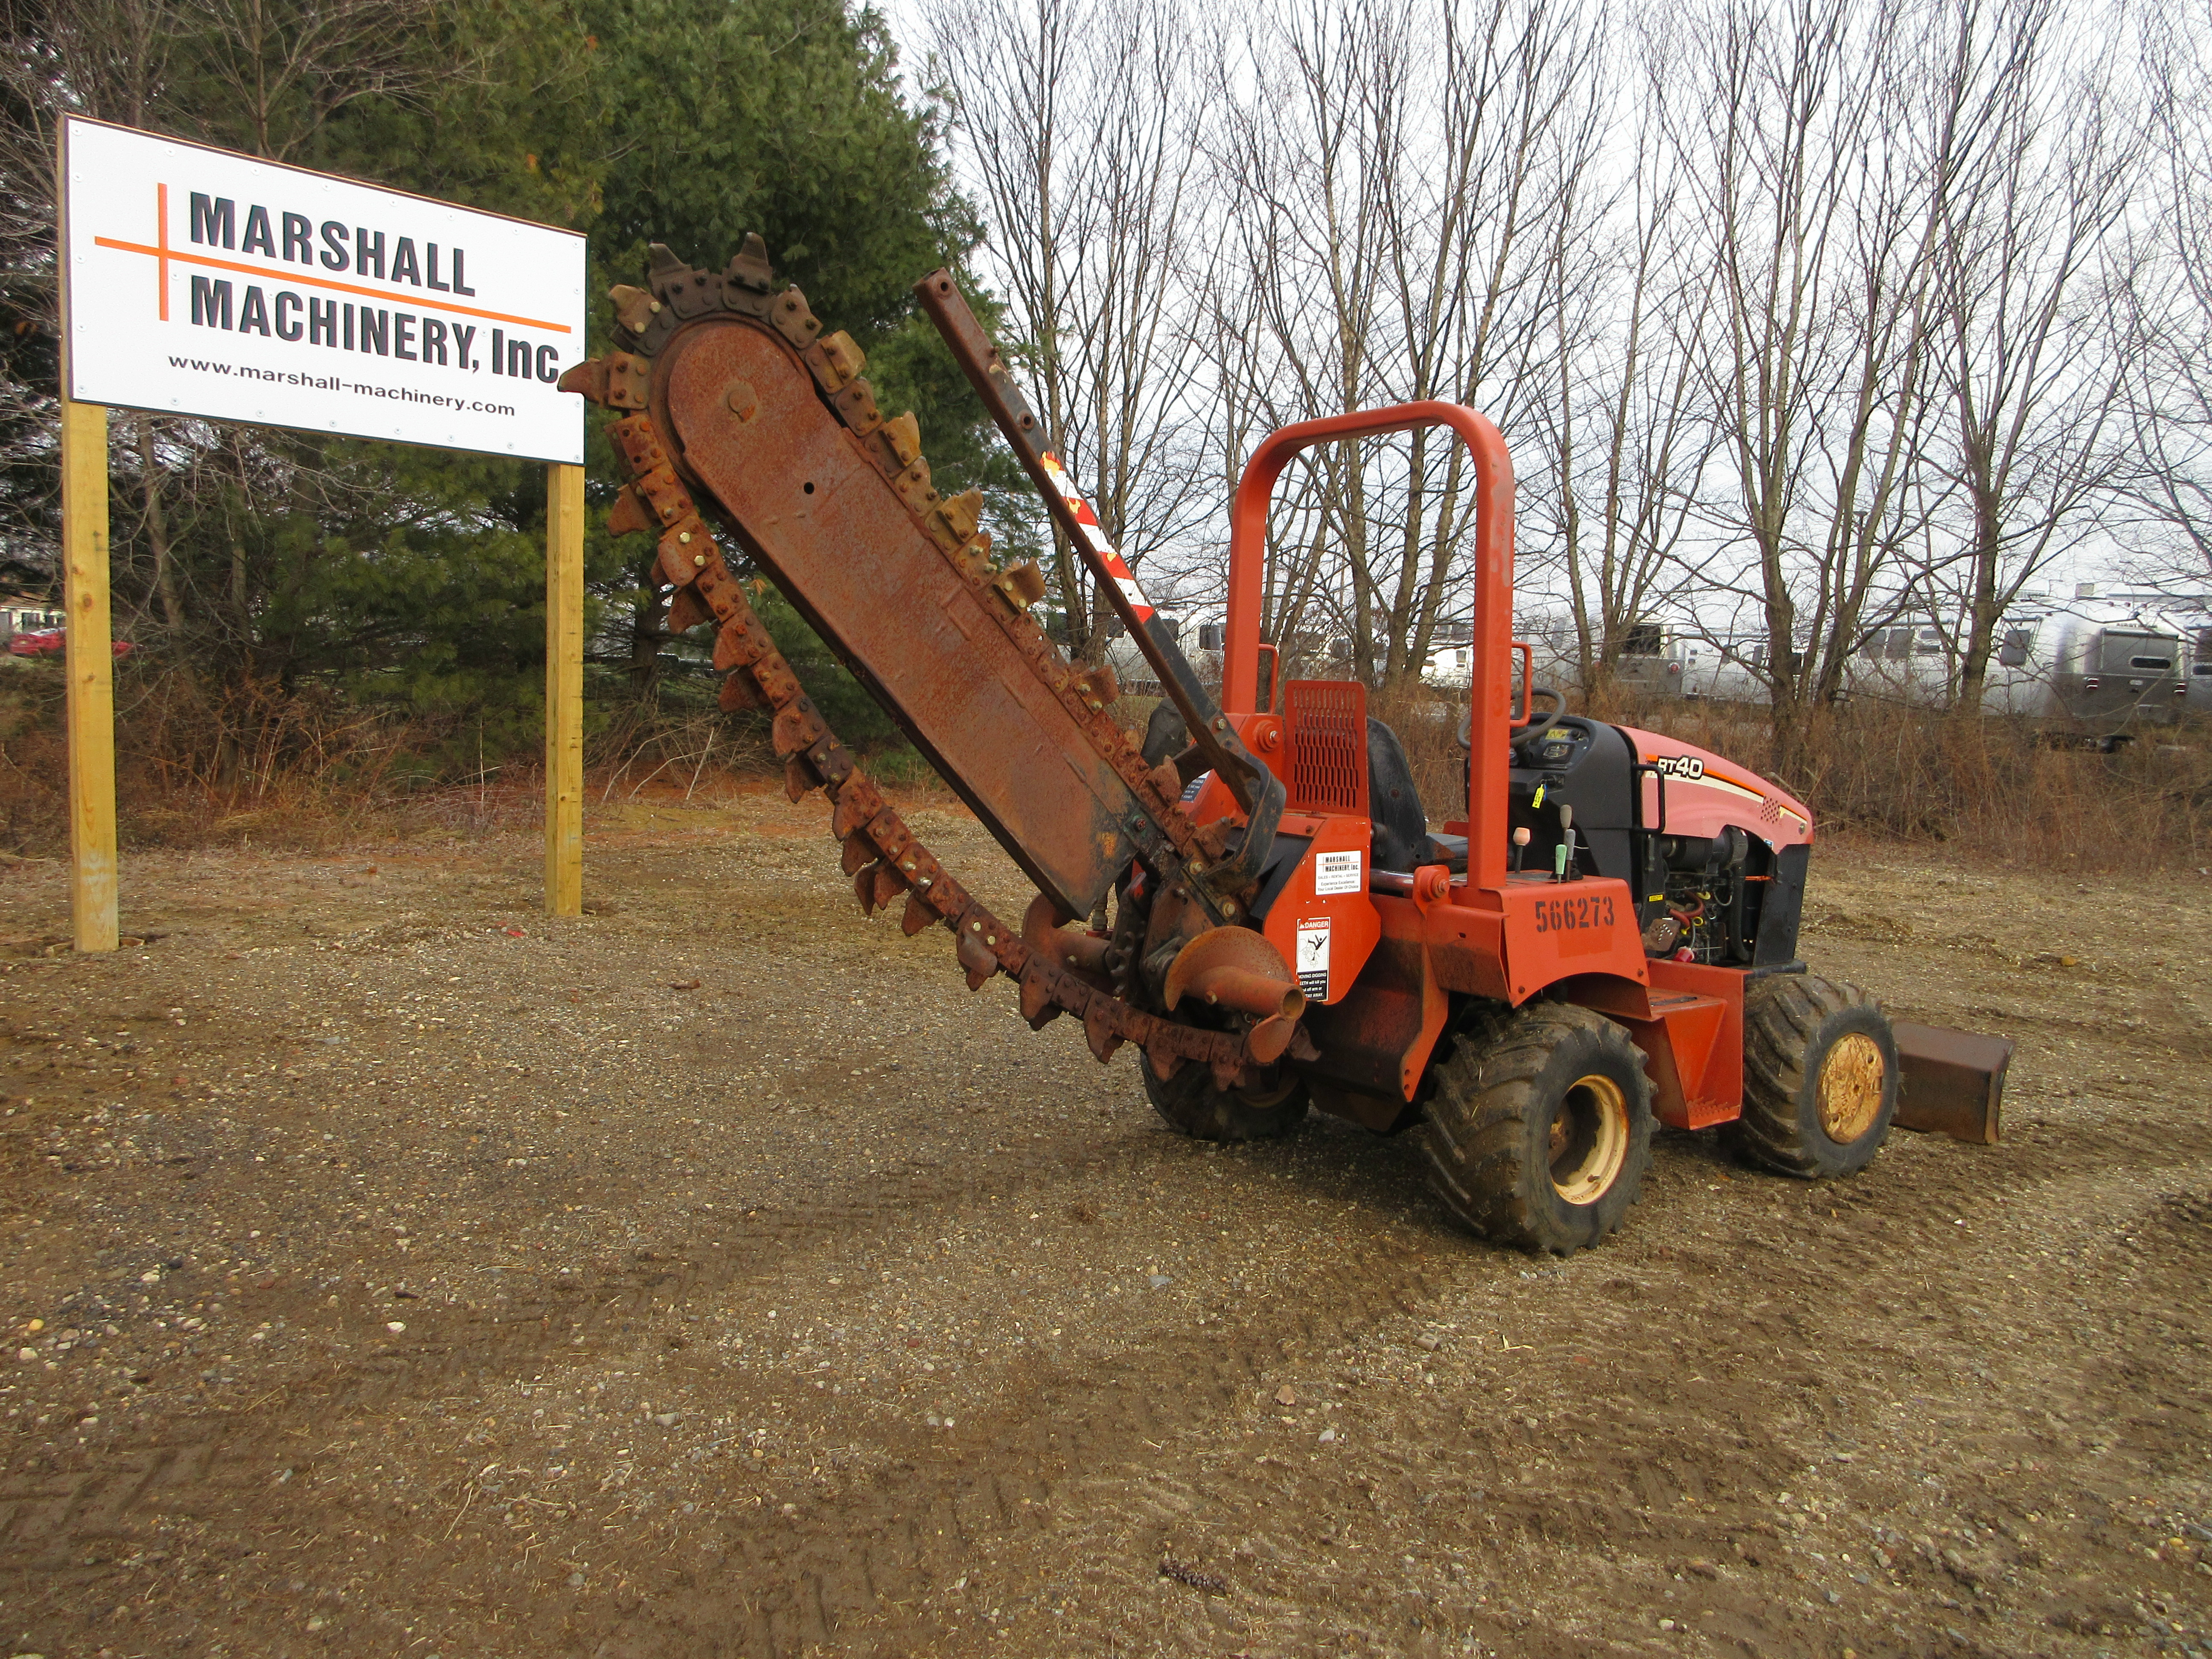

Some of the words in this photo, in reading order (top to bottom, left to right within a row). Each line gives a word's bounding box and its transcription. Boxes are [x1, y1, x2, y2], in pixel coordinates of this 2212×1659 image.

[190, 191, 475, 296] MARSHALL
[191, 274, 479, 373] MACHINERY,
[169, 355, 515, 417] www.marshall-machinery.com
[1658, 757, 1703, 777] RT40
[1535, 896, 1615, 933] 566273
